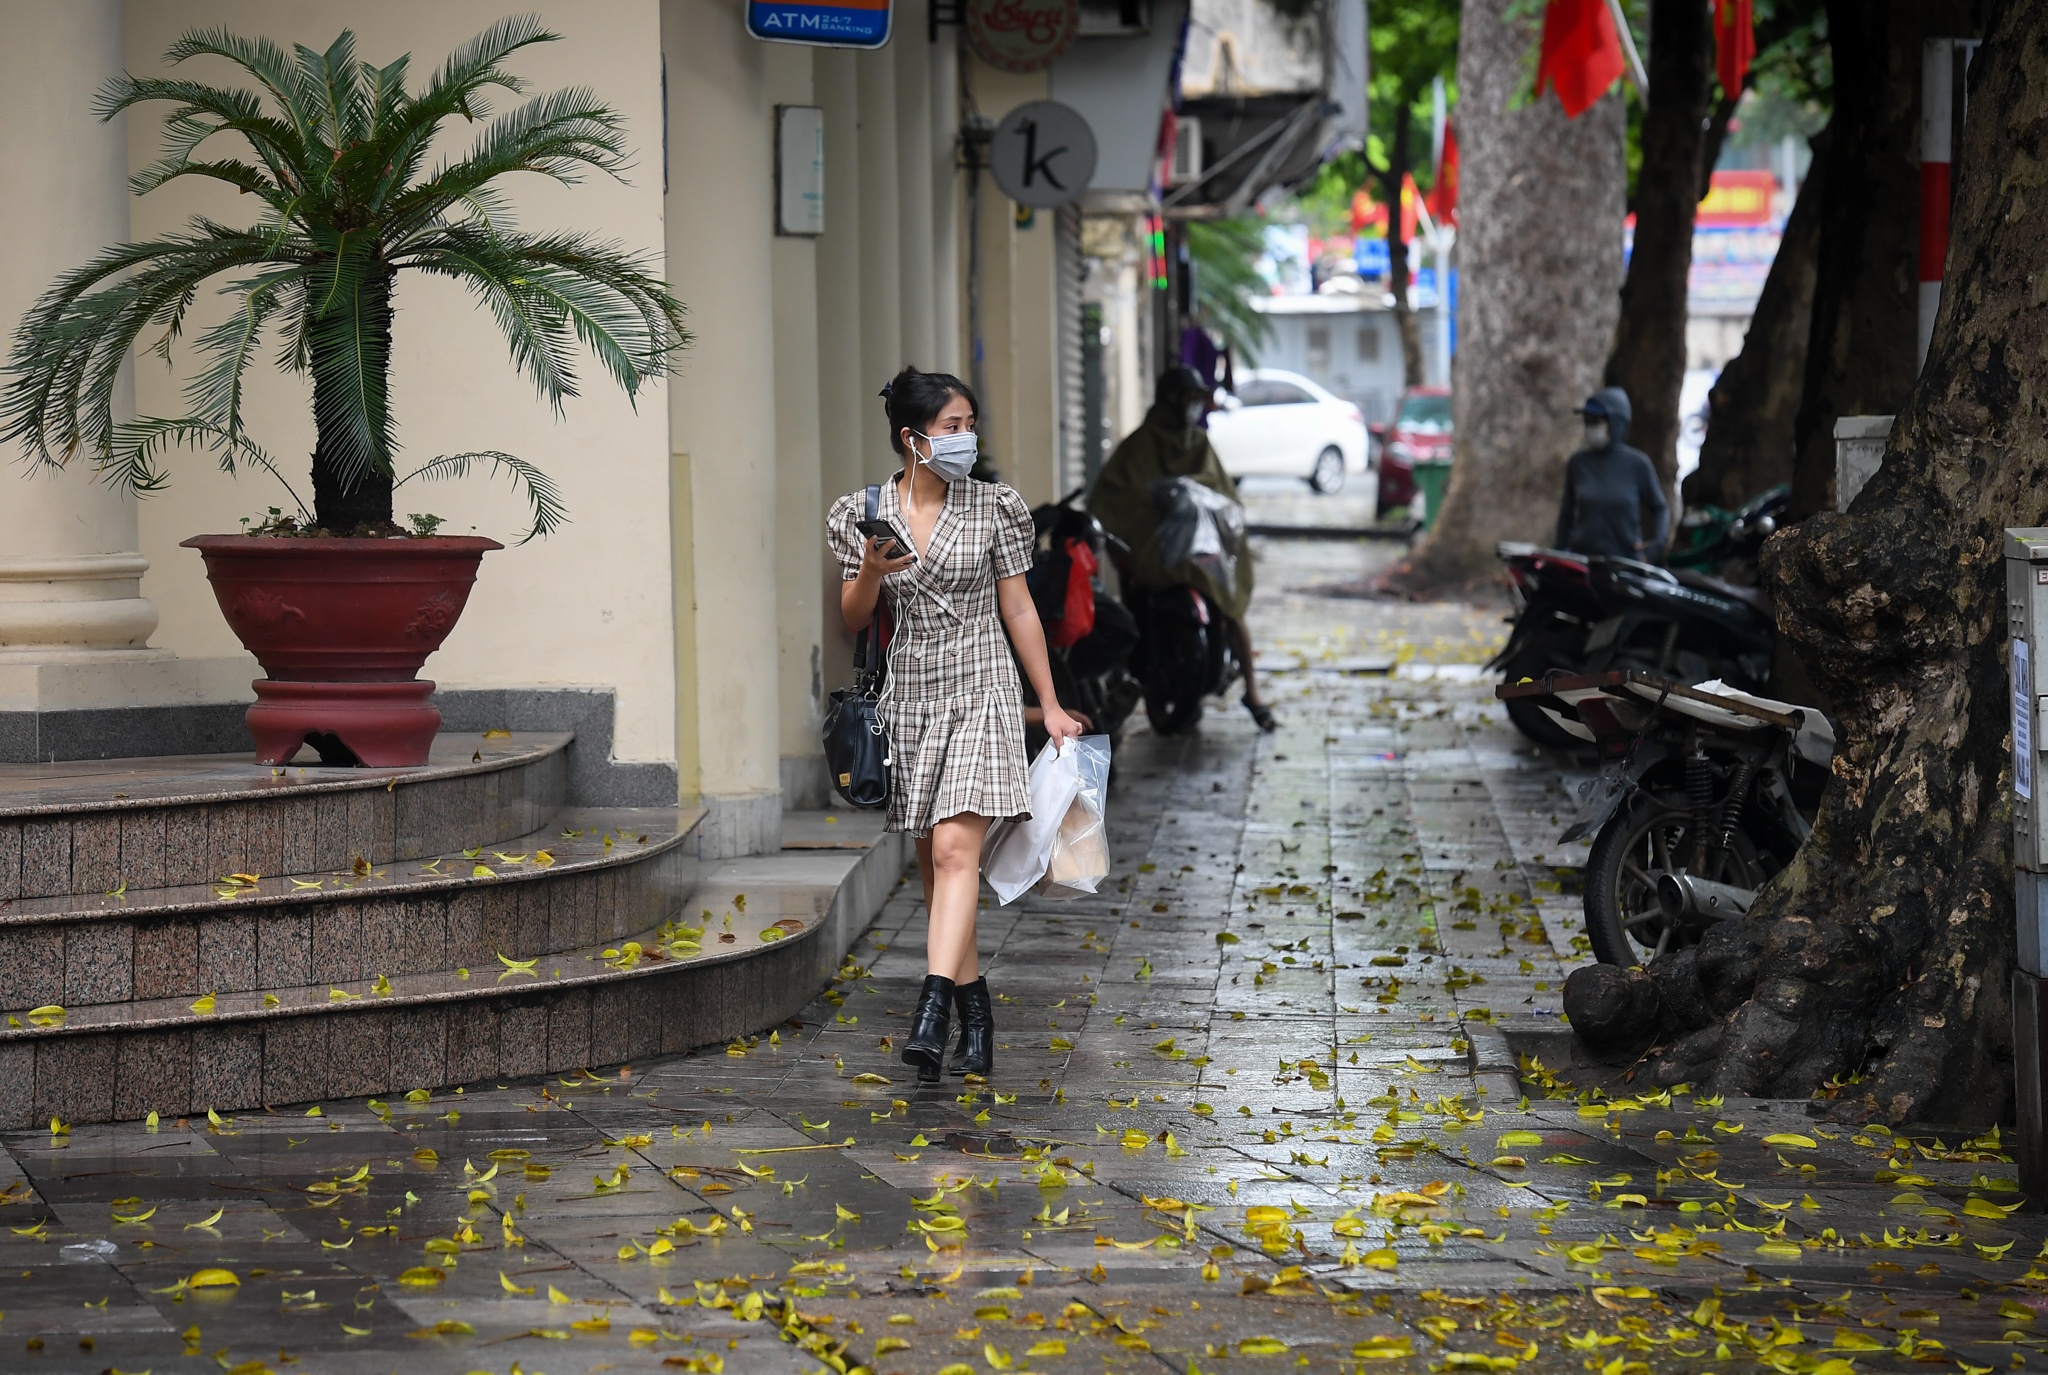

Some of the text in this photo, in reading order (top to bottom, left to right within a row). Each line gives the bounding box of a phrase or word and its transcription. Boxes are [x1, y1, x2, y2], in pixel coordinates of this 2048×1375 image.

[763, 12, 852, 30] ATM 24/7
[821, 23, 873, 35] BANKING
